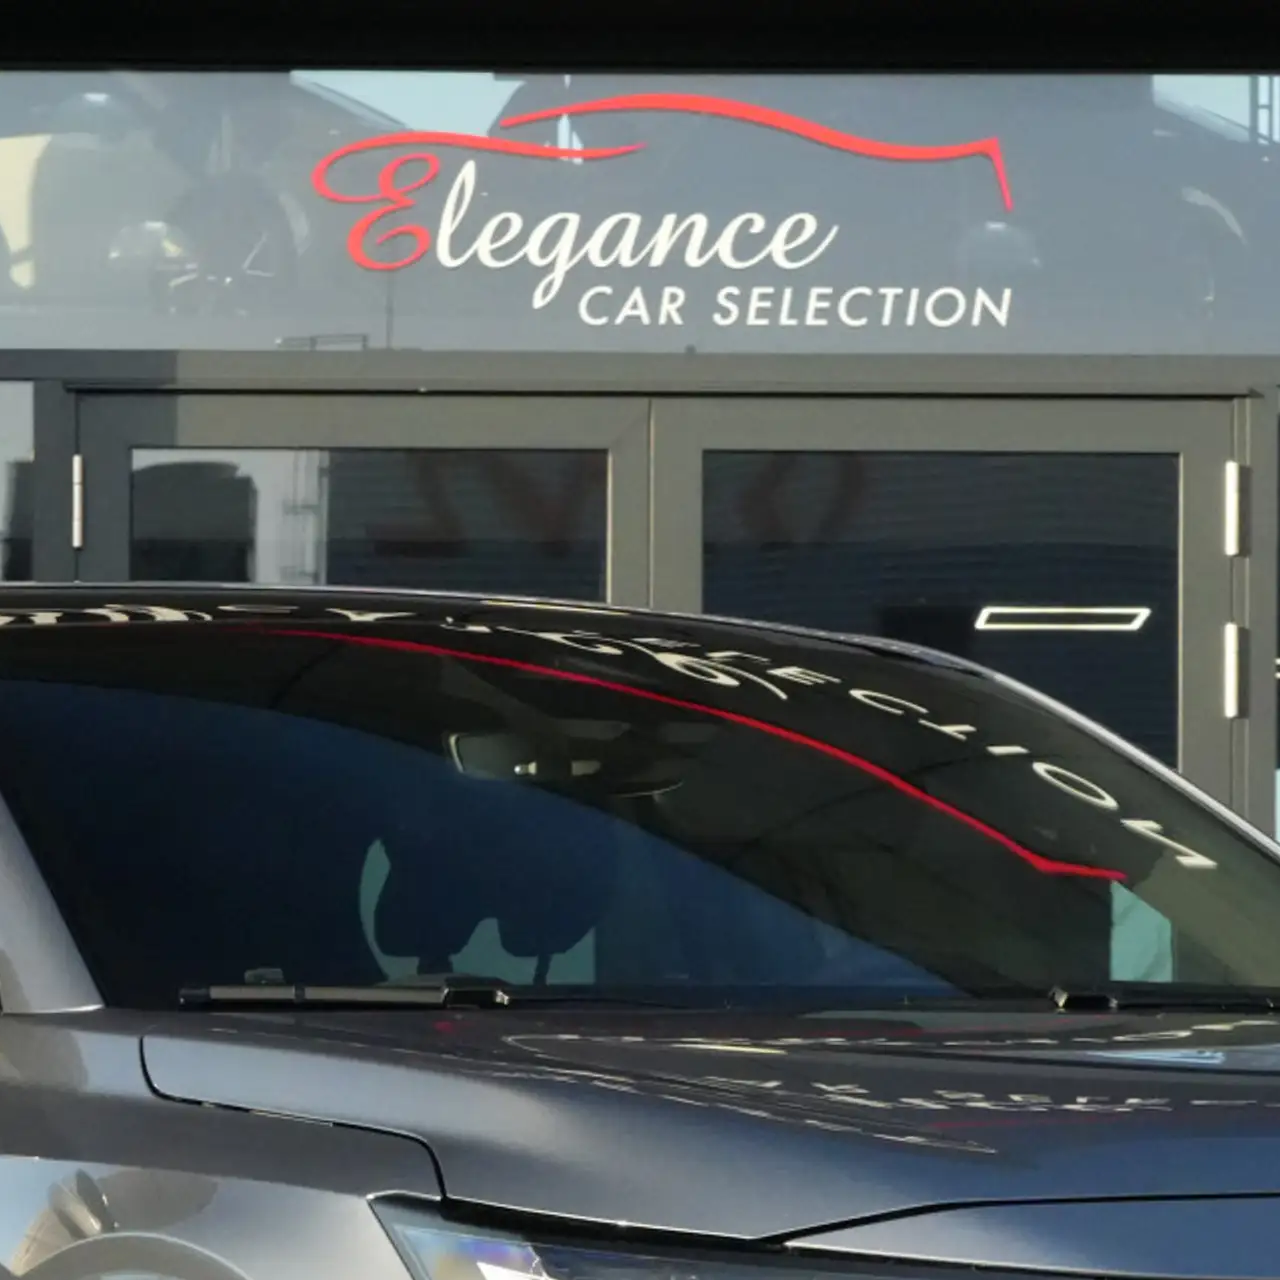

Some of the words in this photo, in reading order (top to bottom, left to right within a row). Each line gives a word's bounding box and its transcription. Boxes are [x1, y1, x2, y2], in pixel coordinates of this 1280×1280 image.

[311, 132, 838, 309] Elegance
[578, 285, 685, 326] CAR
[712, 285, 1013, 328] SELECTION
